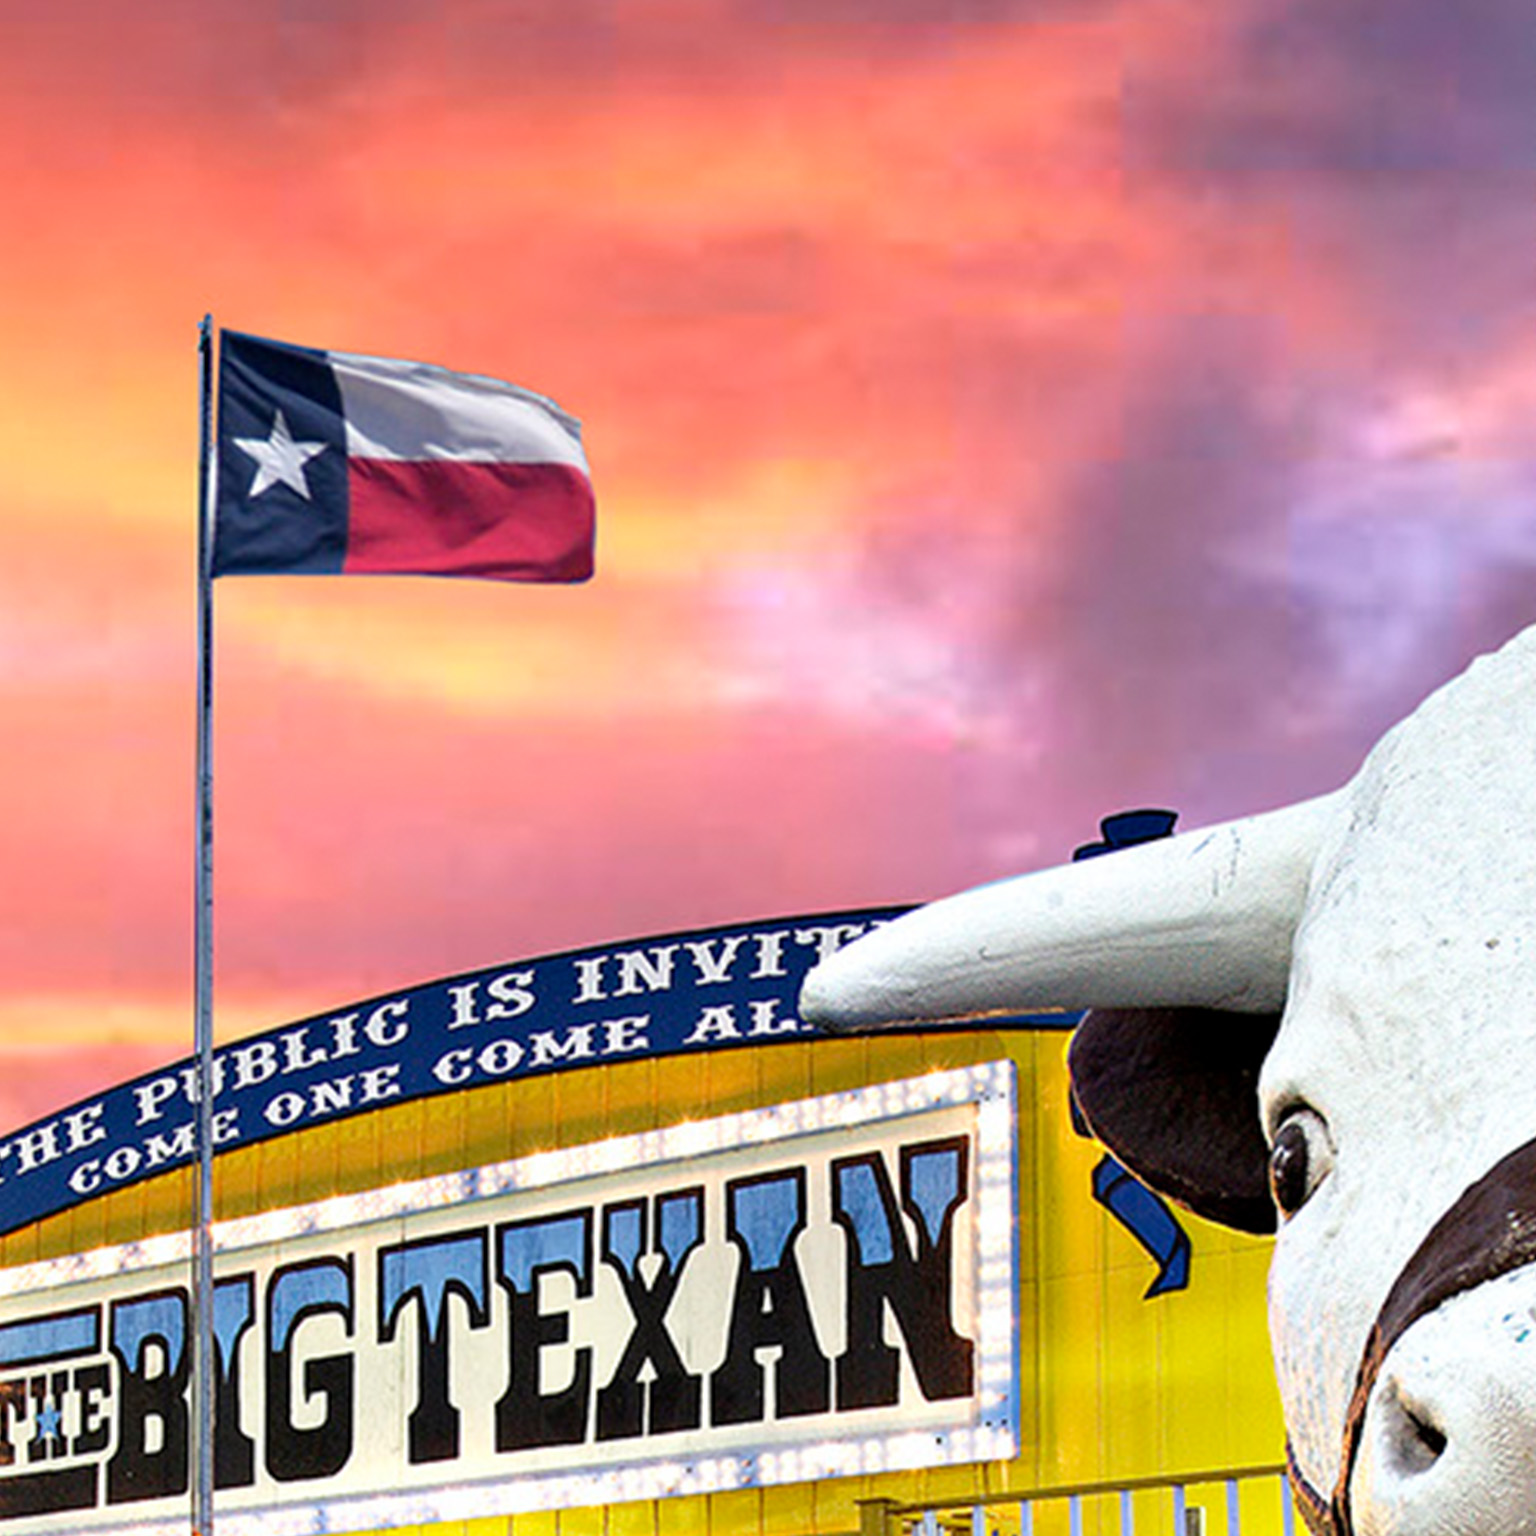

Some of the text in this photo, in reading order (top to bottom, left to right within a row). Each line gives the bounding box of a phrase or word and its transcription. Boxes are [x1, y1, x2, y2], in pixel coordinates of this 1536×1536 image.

[67, 998, 815, 1195] COME ONE COME AL
[134, 998, 410, 1127] PUBLIC
[448, 968, 535, 1031] IS
[572, 920, 882, 1004] INVIT
[105, 1251, 355, 1507] BIG
[377, 1132, 976, 1466] TEXAN
